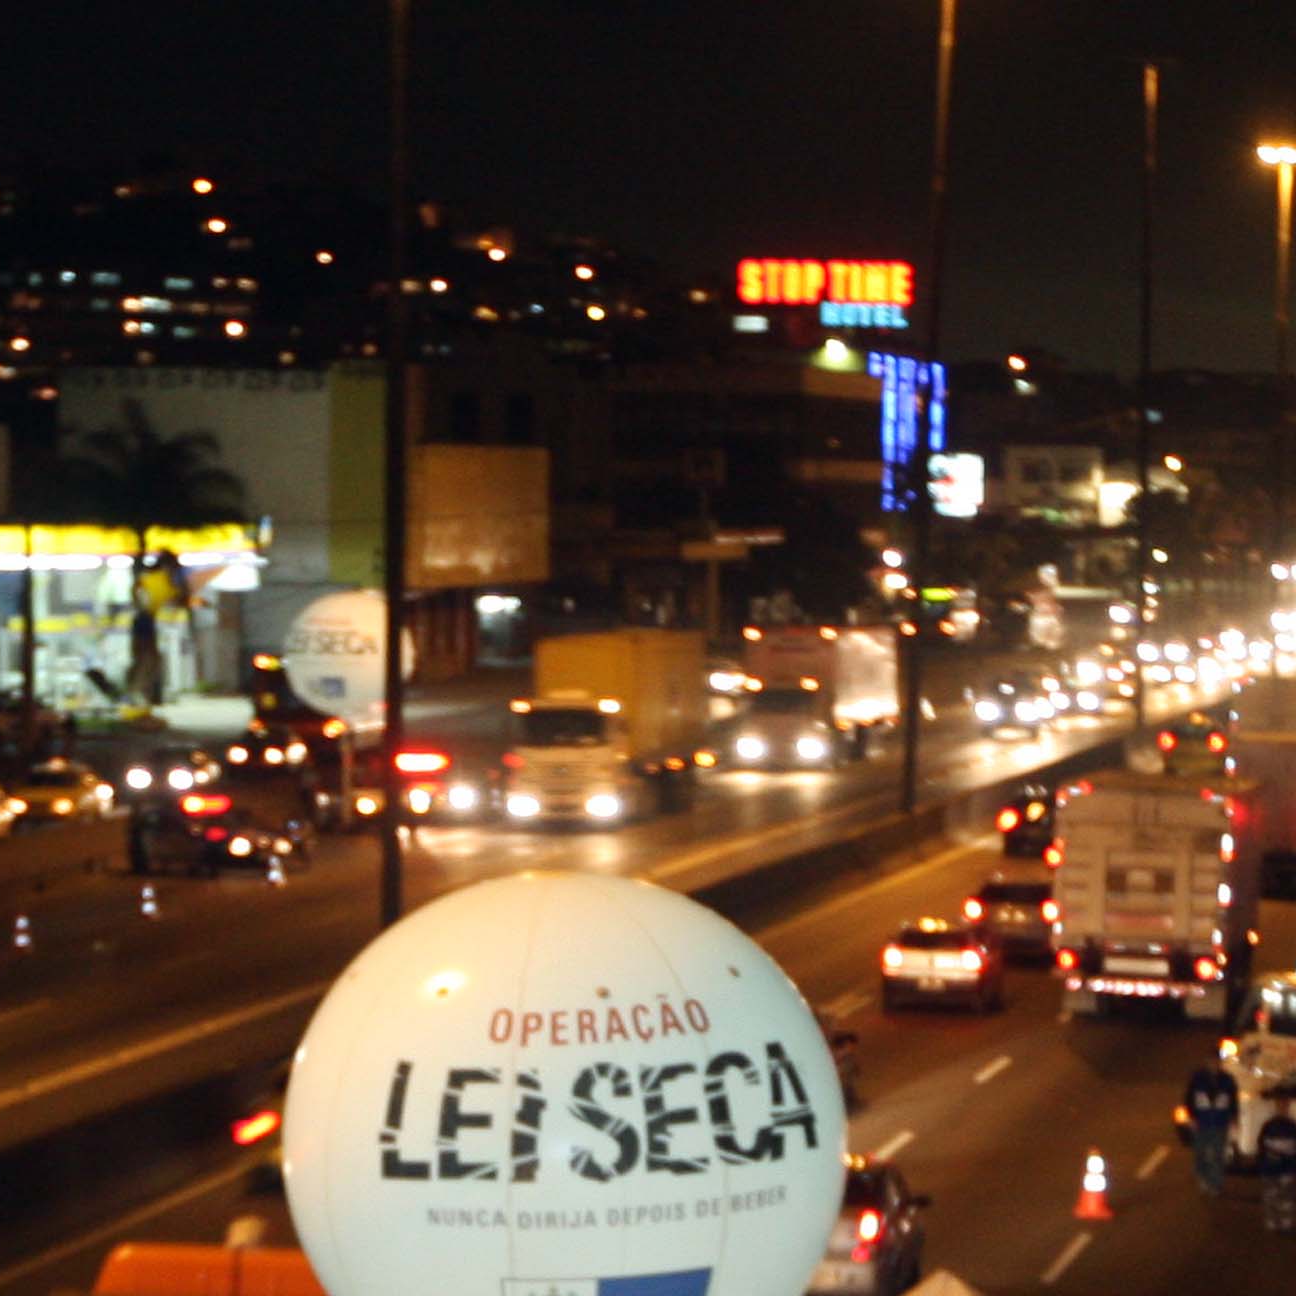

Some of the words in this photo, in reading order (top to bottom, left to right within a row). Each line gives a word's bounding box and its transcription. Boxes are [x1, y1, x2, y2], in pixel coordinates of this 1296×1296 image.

[737, 258, 824, 305] STOP
[826, 260, 915, 306] TIME
[488, 994, 712, 1048] OPERAÇÃO
[379, 1060, 548, 1184] LEI
[568, 1042, 819, 1184] SECA
[426, 1206, 507, 1229] NUNCA
[516, 1209, 598, 1231] DIRIJA
[606, 1202, 688, 1229] DEPOIS
[695, 1197, 722, 1217] DE
[728, 1184, 790, 1215] BEBER
